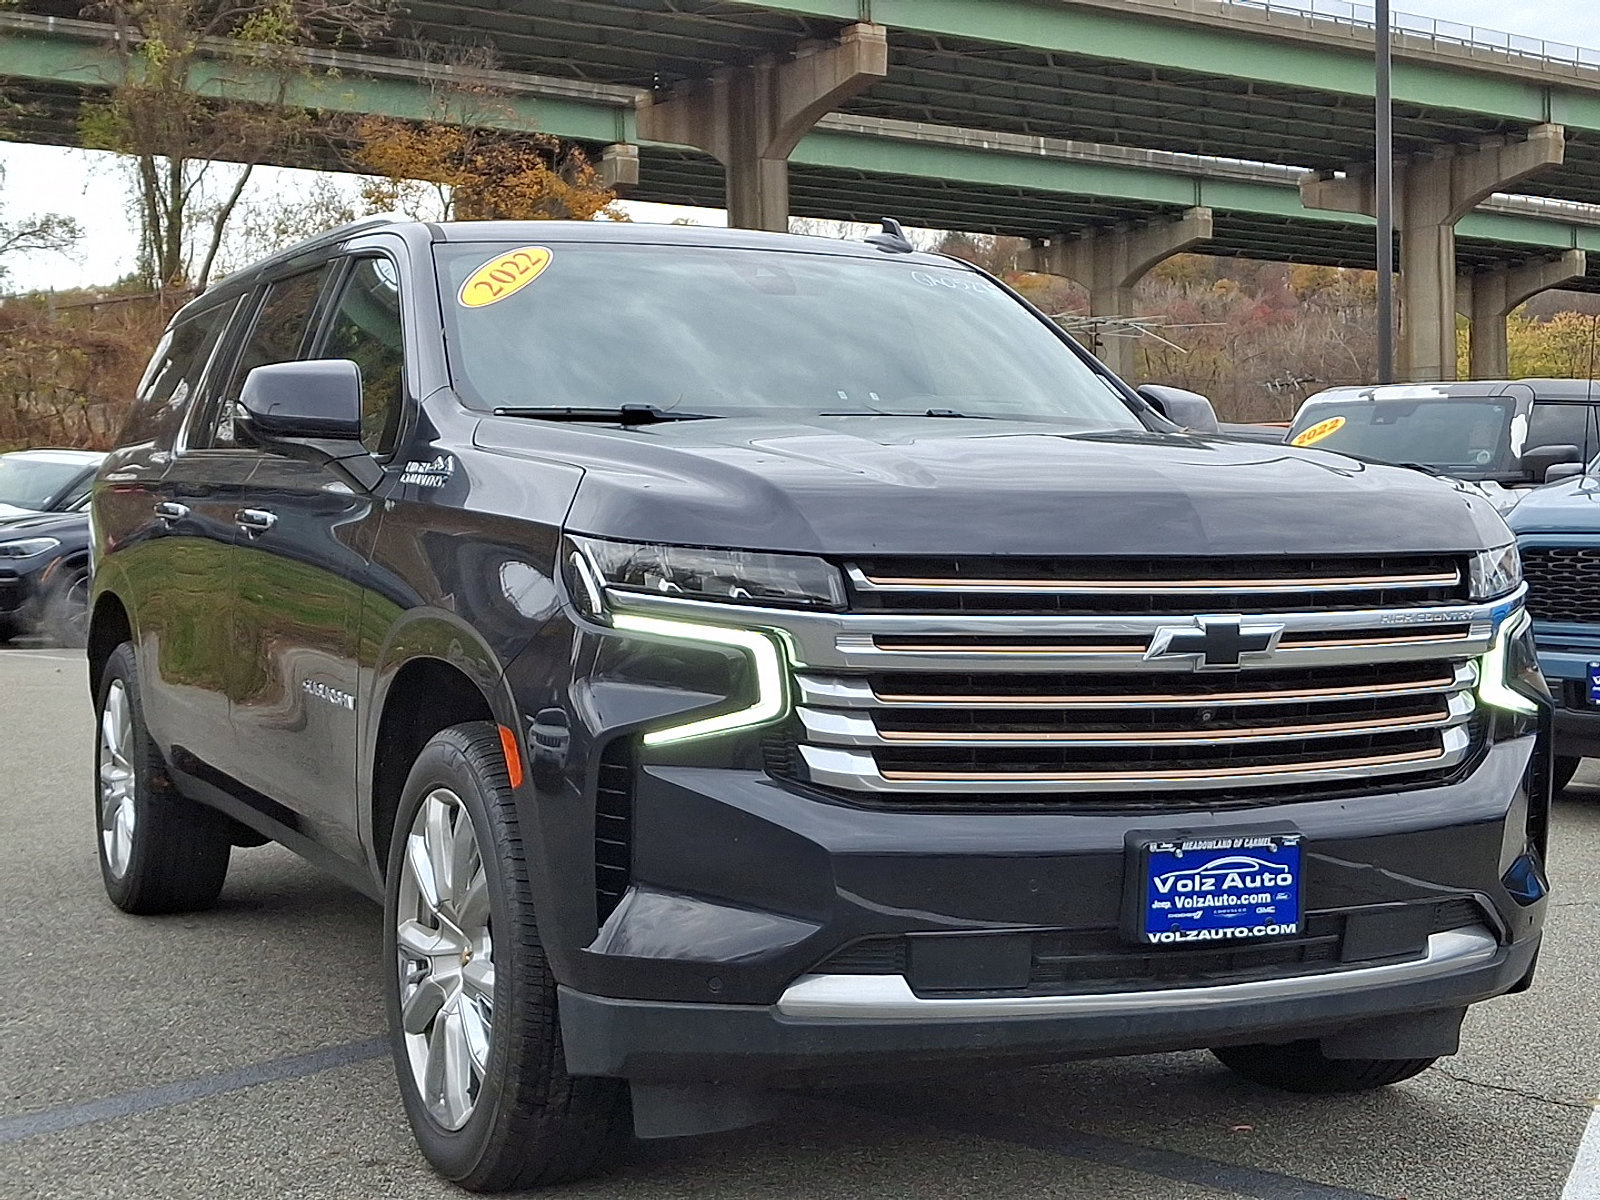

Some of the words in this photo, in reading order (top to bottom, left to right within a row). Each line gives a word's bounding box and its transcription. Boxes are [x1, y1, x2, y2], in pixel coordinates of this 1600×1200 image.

[474, 252, 543, 297] 2022
[1297, 418, 1340, 445] 2022
[1153, 874, 1216, 894] Volz
[1221, 871, 1293, 890] Auto
[1174, 892, 1271, 909] VolzAuto.com
[1255, 905, 1276, 914] GMC
[1147, 923, 1297, 944] VOLZAUTO.COM
